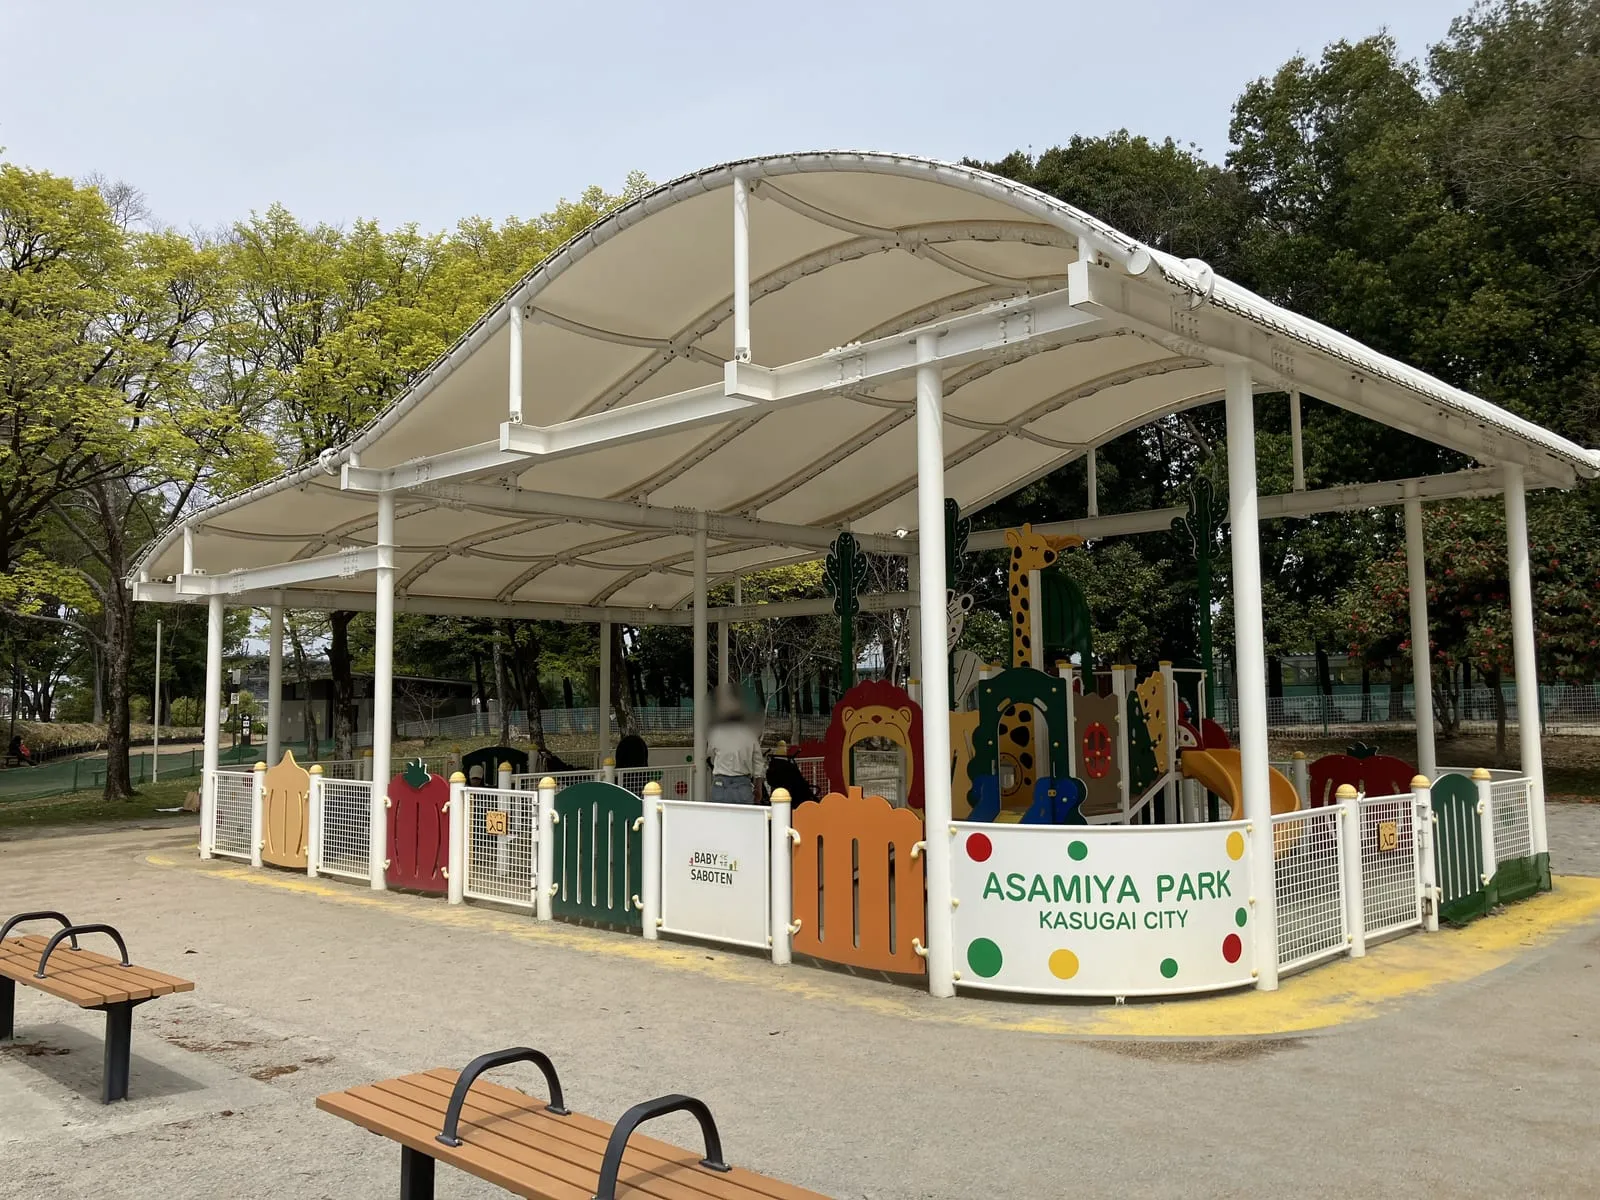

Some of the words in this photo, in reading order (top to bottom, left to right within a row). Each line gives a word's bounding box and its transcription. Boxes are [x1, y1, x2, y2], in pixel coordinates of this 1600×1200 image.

[489, 819, 504, 832] 入口
[1381, 833, 1395, 848] 入口
[694, 851, 718, 865] BABY
[690, 868, 733, 885] SABOTEN
[982, 871, 1141, 903] ASAMIYA
[1156, 869, 1232, 902] PARK
[1039, 910, 1136, 930] KASUGAI
[1143, 909, 1189, 929] CITY
